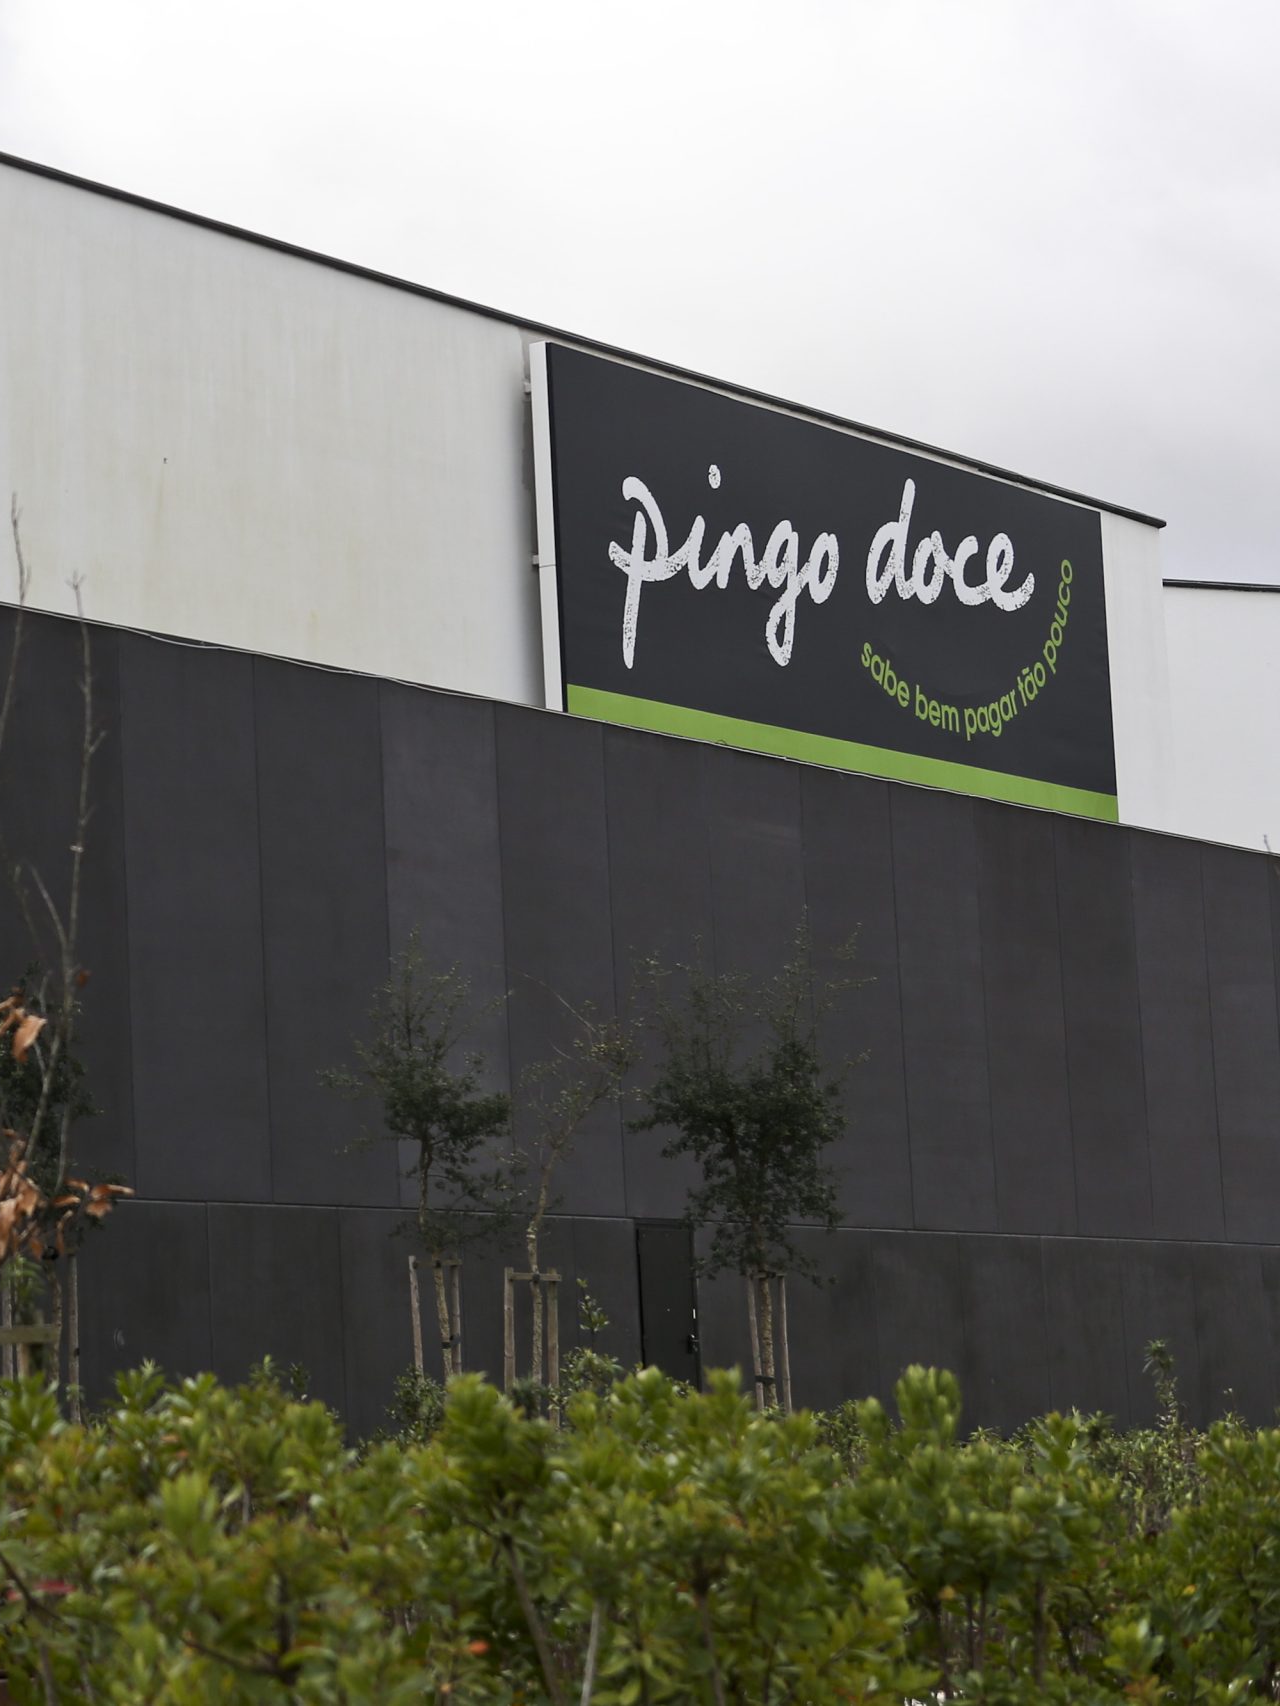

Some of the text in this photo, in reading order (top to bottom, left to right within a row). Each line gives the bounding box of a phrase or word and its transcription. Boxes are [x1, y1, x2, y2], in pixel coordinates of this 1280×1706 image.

[608, 464, 1036, 669] pingo doce
[861, 559, 1073, 742] sabe bem pagar tão pouco
